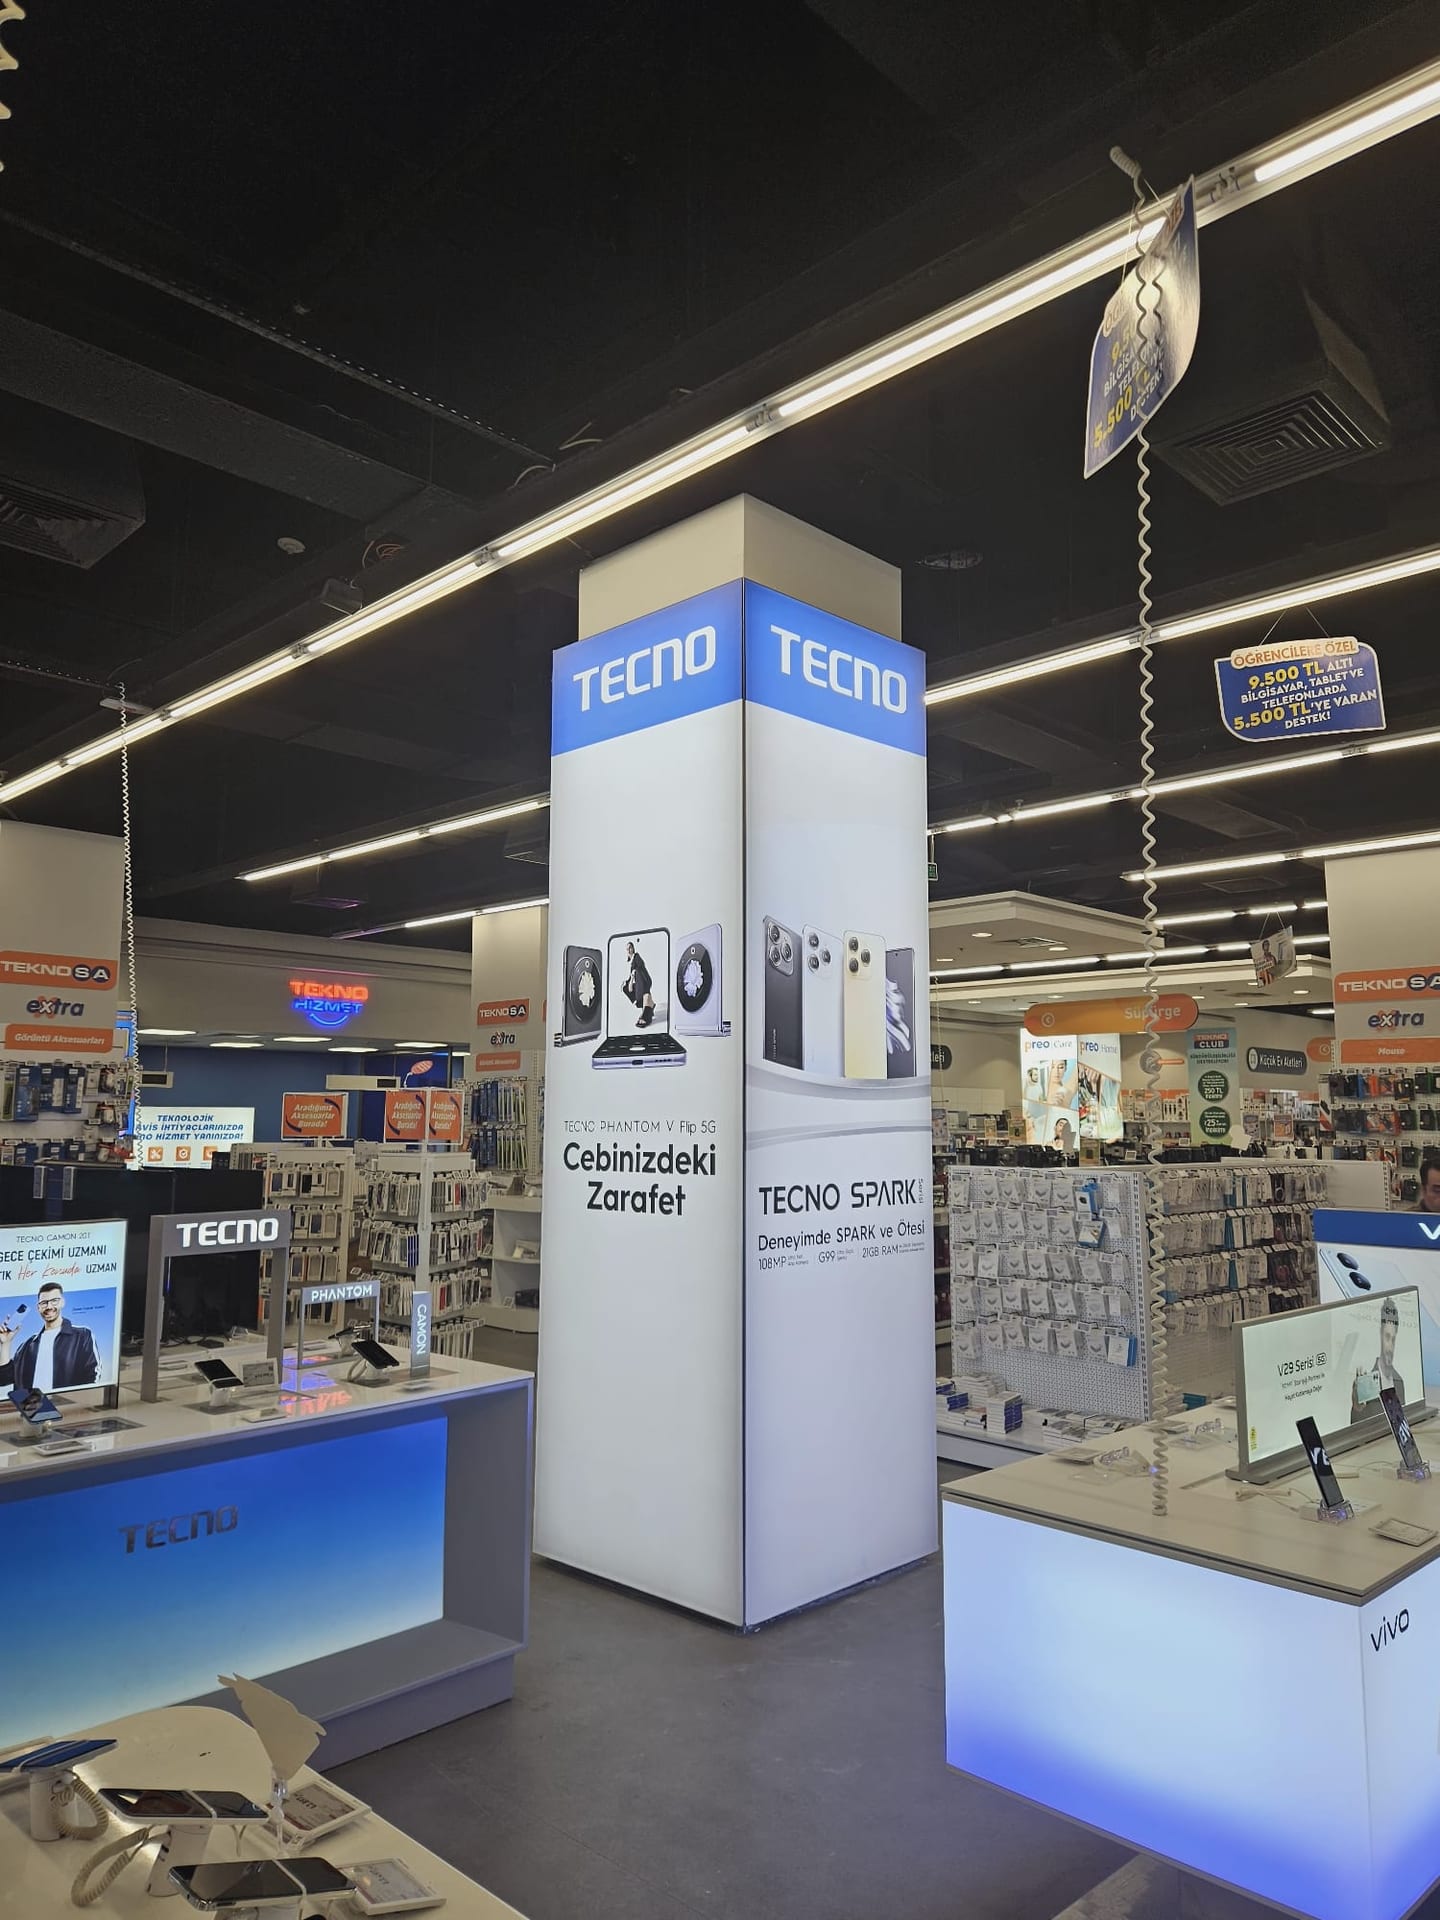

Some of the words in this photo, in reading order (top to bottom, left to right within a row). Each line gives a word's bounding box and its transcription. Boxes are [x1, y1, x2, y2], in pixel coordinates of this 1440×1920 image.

[1130, 363, 1163, 422] DSTEK!
[1233, 643, 1321, 667] ÖĞRENCİLERE
[1324, 641, 1356, 654] ÖZEL
[573, 625, 716, 712] TECNO
[770, 624, 907, 714] TECNO
[1249, 666, 1299, 690] 9.500
[1302, 662, 1325, 677] TL
[1327, 658, 1353, 673] ALTI
[1241, 681, 1308, 704] BİLGİSAYAR,
[1309, 671, 1349, 687] TABLET
[1349, 667, 1364, 679] VE
[1262, 684, 1347, 709] TELEFONLARDA
[1233, 706, 1285, 731] 5.500
[1333, 689, 1378, 708] VARAN
[1285, 712, 1331, 729] DESTEK!
[0, 960, 109, 980] TEKNOSA
[289, 980, 369, 1001] TEKNO
[1339, 972, 1440, 993] TEKNOSA
[26, 997, 85, 1017] extra
[479, 1005, 526, 1018] TEKNOSA
[1368, 1008, 1425, 1030] extra
[14, 1033, 51, 1043] Görüntü
[52, 1034, 105, 1046] Aksesuarları
[490, 1031, 516, 1046] extra
[1024, 1040, 1050, 1053] preo
[1080, 1041, 1099, 1055] preo
[1199, 1040, 1225, 1048] CLUB
[157, 1113, 214, 1122] TEKNOLOJİK
[563, 1120, 596, 1133] TECNO
[600, 1120, 660, 1133] PHANTOM
[666, 1120, 674, 1132] V
[680, 1120, 697, 1136] Flip
[701, 1120, 716, 1133] 5G
[155, 1132, 191, 1140] HİZMET
[563, 1142, 716, 1176] Cebinizdeki
[587, 1180, 686, 1216] Zarafet
[758, 1183, 840, 1215] TECNO
[851, 1178, 916, 1208] SPARK
[16, 1235, 44, 1243] TECNO
[46, 1233, 77, 1241] CAMON
[176, 1217, 279, 1248] TECNO
[758, 1229, 832, 1252] Deneyimde
[836, 1224, 876, 1244] SPARK
[880, 1226, 894, 1239] ve
[897, 1219, 925, 1237] Ötesi
[0, 1250, 24, 1262] GECE
[27, 1245, 64, 1263] ÇEKİMİ
[68, 1244, 107, 1258] UZMANI
[758, 1255, 787, 1271] 108MP
[818, 1251, 836, 1263] G99
[882, 1246, 899, 1256] RAM
[17, 1264, 38, 1281] Her
[86, 1262, 117, 1274] UZMAN
[311, 1284, 373, 1302] PHANTOM
[417, 1304, 427, 1355] CAMON
[1277, 1361, 1294, 1377] V29
[1295, 1355, 1314, 1372] Serisi
[118, 1504, 239, 1554] TECNO
[1370, 1608, 1410, 1652] vivo
